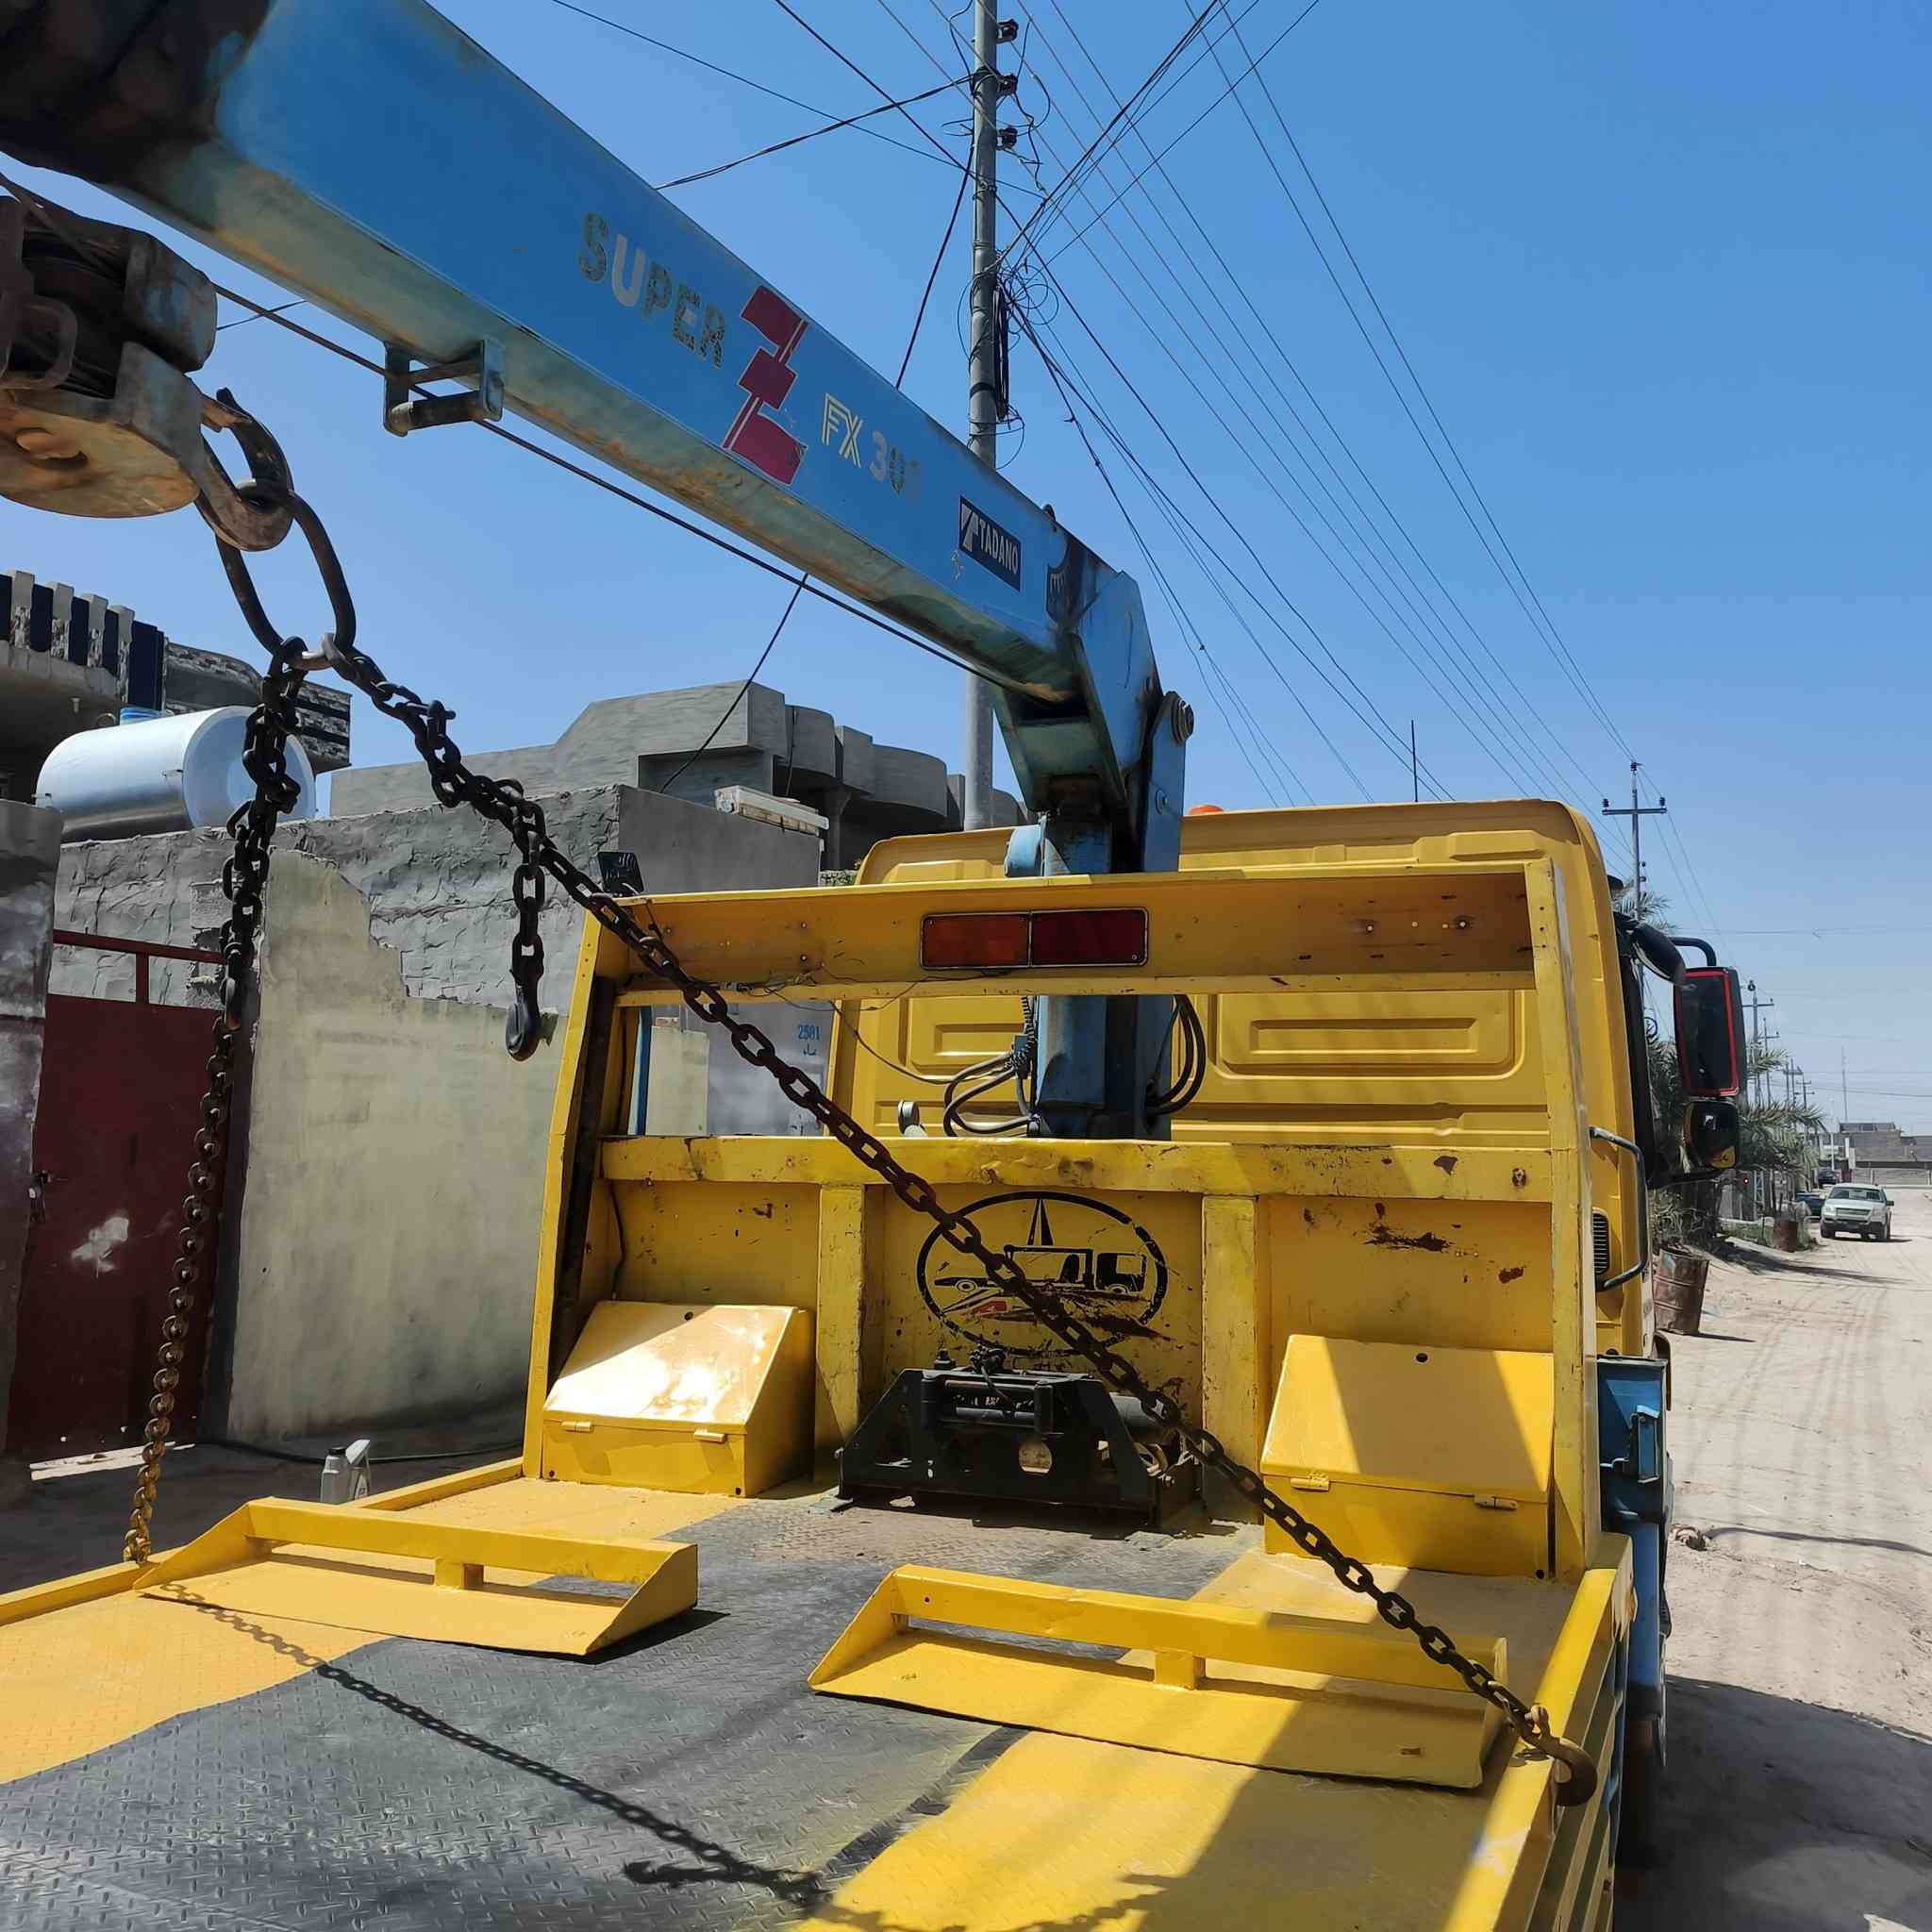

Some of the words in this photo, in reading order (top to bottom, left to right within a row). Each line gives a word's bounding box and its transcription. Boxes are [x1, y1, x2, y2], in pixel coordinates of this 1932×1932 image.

[578, 211, 724, 369] SUPER
[822, 392, 863, 468] FX
[979, 518, 1019, 575] TADANO
